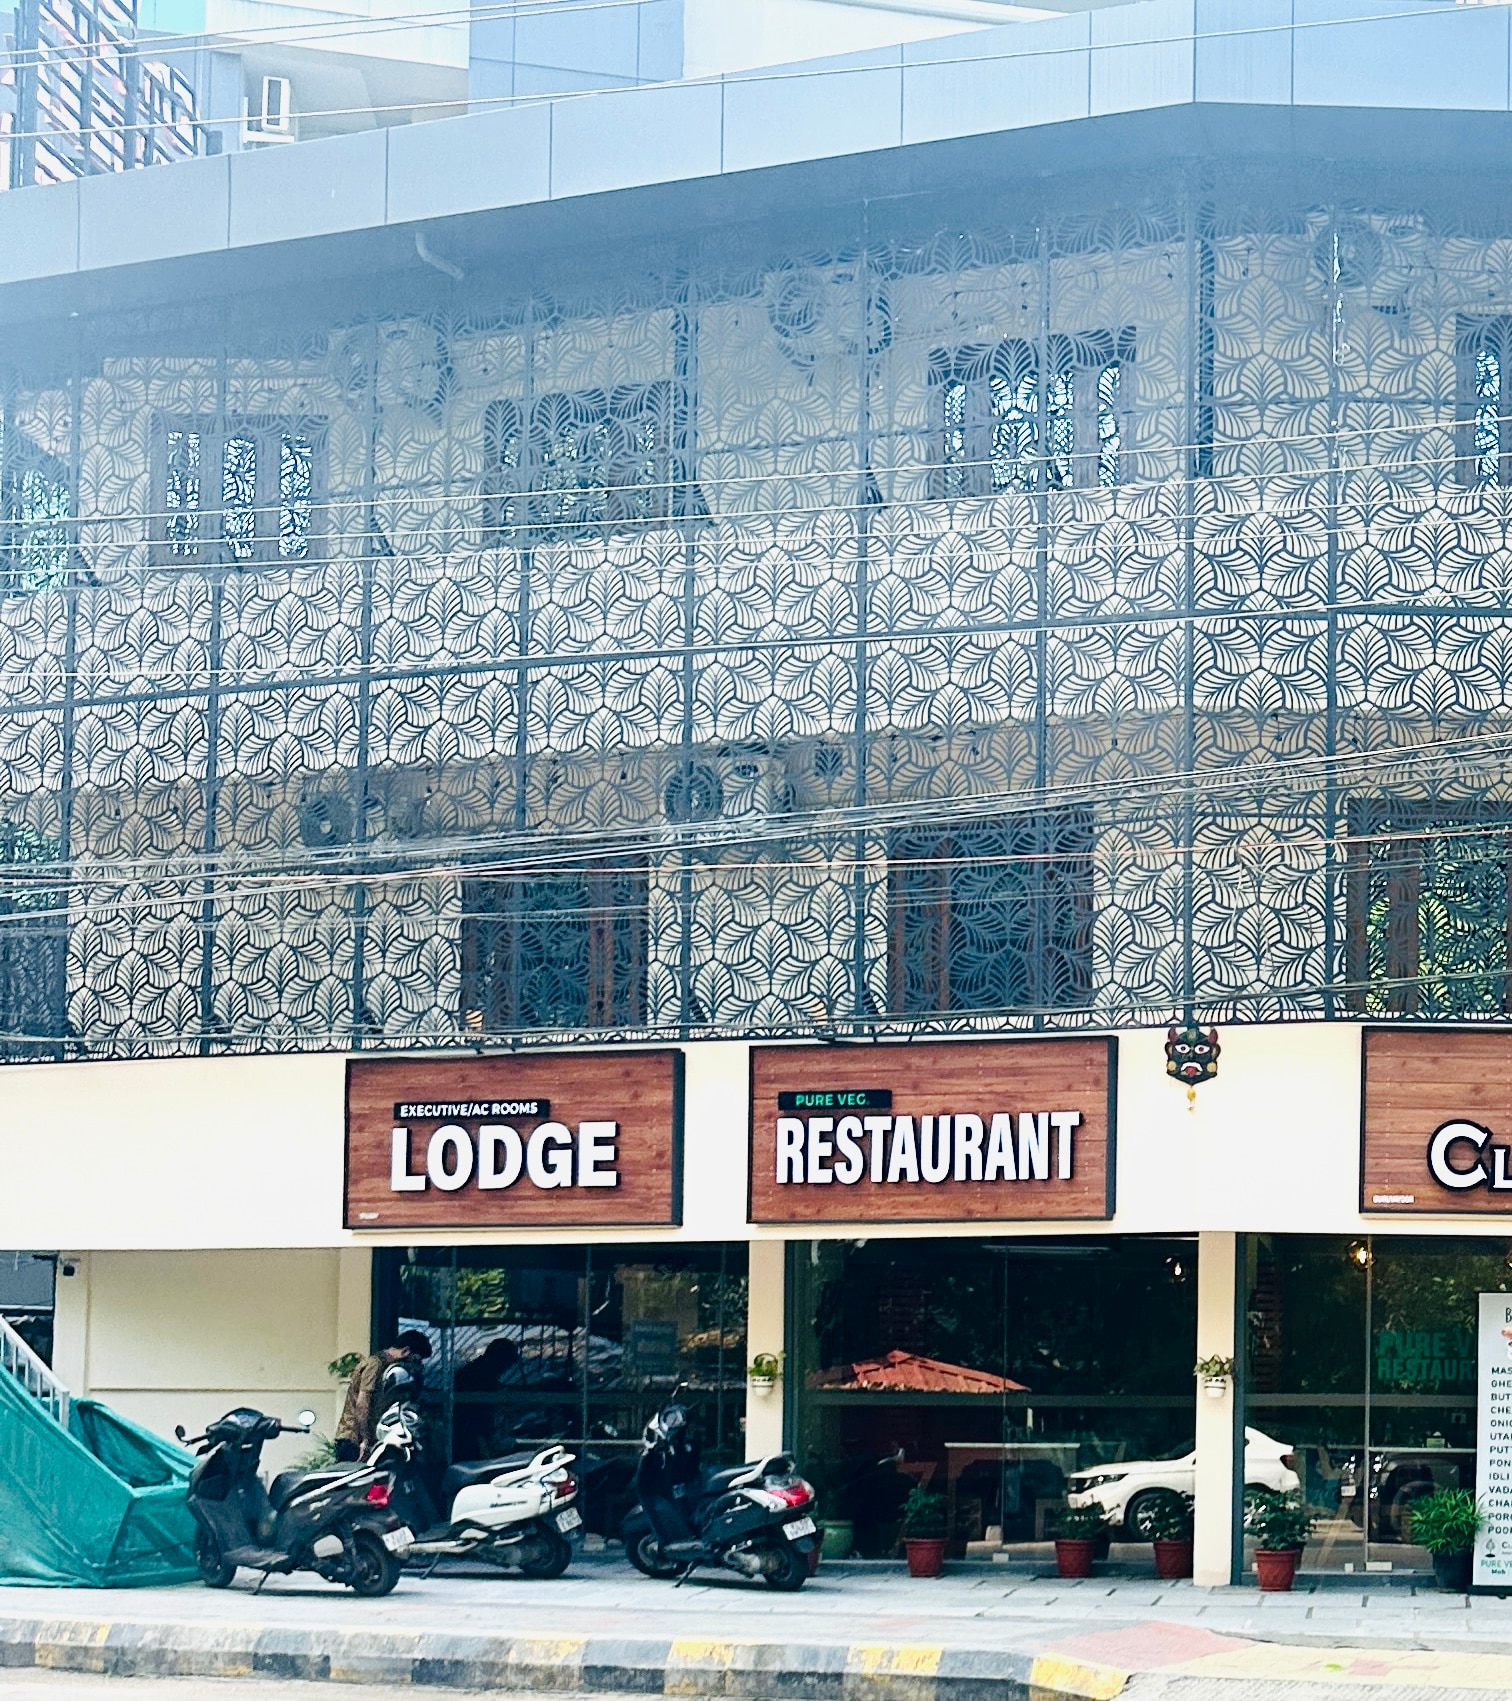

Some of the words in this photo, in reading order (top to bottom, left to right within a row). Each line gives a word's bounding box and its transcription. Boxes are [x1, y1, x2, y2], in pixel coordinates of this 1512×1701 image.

[795, 1094, 833, 1106] PURE
[400, 1103, 489, 1118] EXECUTIVE/AC
[492, 1102, 538, 1116] ROOMS
[391, 1121, 617, 1191] LODGE
[776, 1111, 1080, 1184] RESTAURANT
[1378, 1330, 1447, 1357] PURE
[1378, 1359, 1476, 1380] RESTAUR
[1489, 1472, 1510, 1480] IDLI
[1480, 1560, 1501, 1568] PURE
